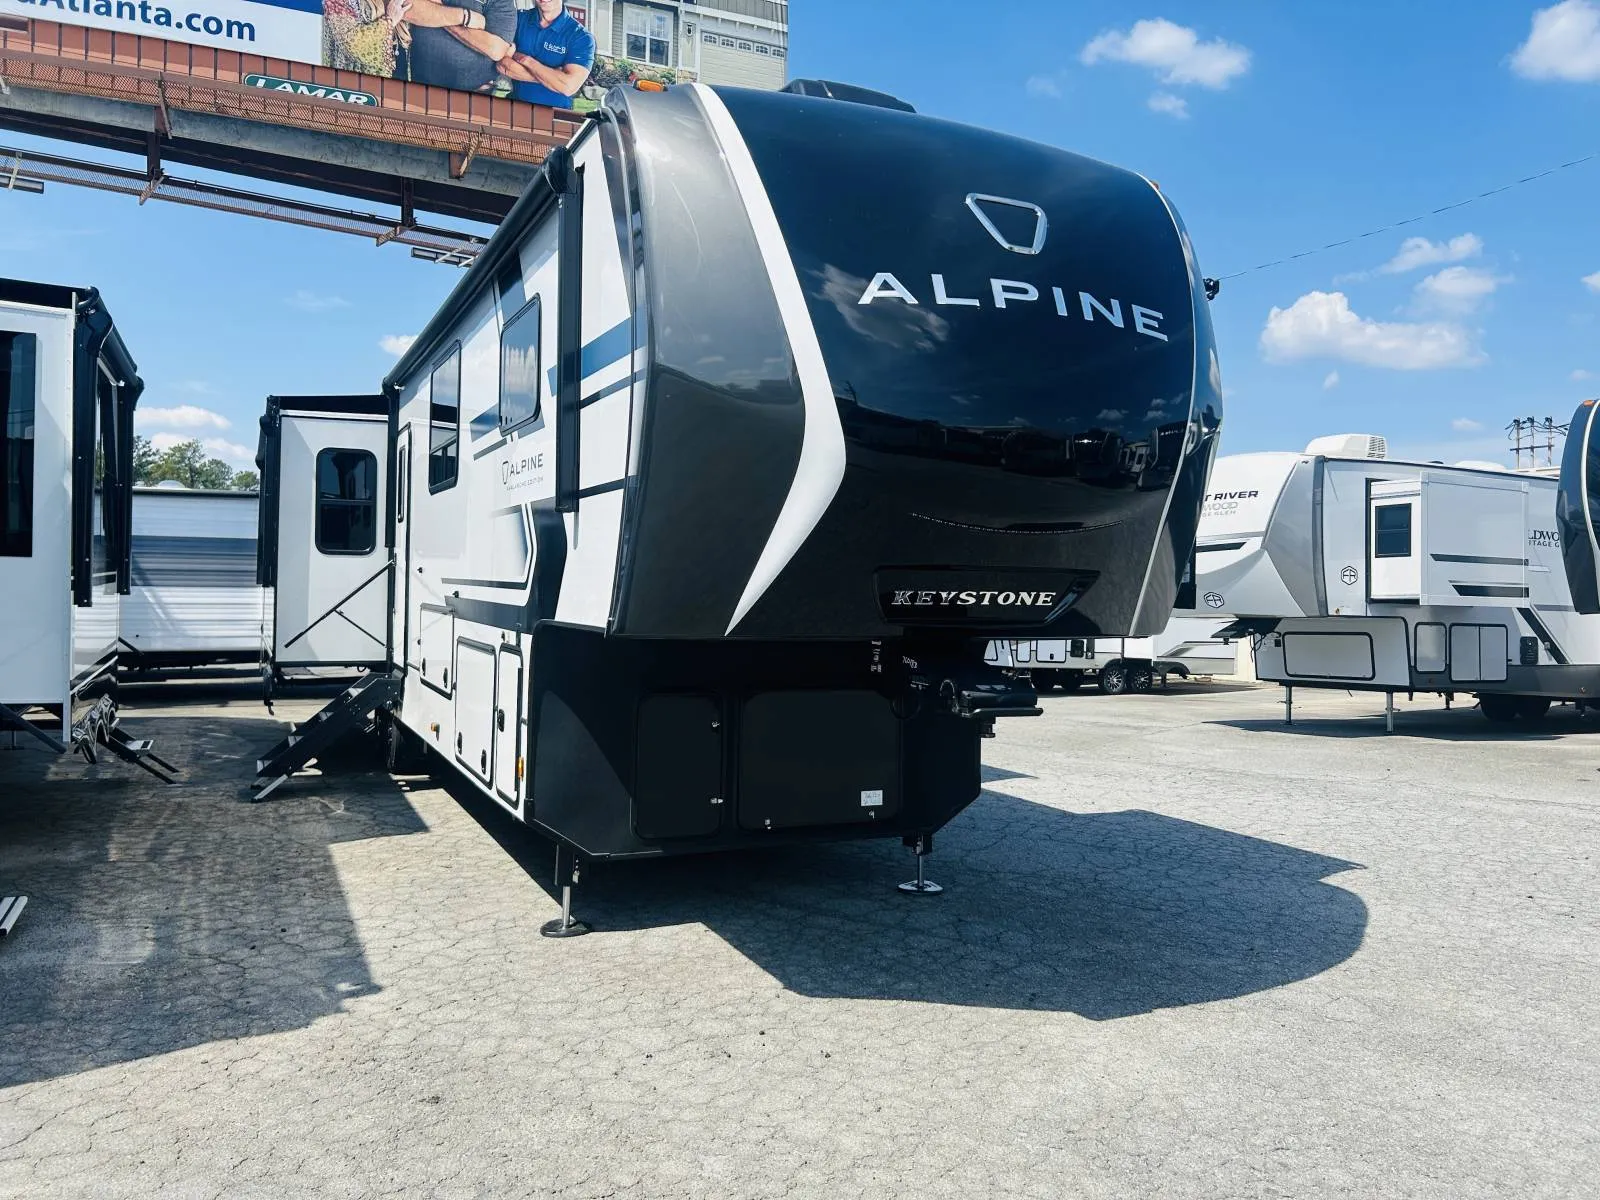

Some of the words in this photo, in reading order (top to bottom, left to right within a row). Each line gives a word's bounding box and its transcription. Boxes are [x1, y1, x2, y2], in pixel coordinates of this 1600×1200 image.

[857, 271, 1169, 342] ALPINE
[509, 452, 544, 477] ALPINE
[1213, 490, 1259, 501] RIVER
[891, 590, 1057, 606] KEYSTONE
